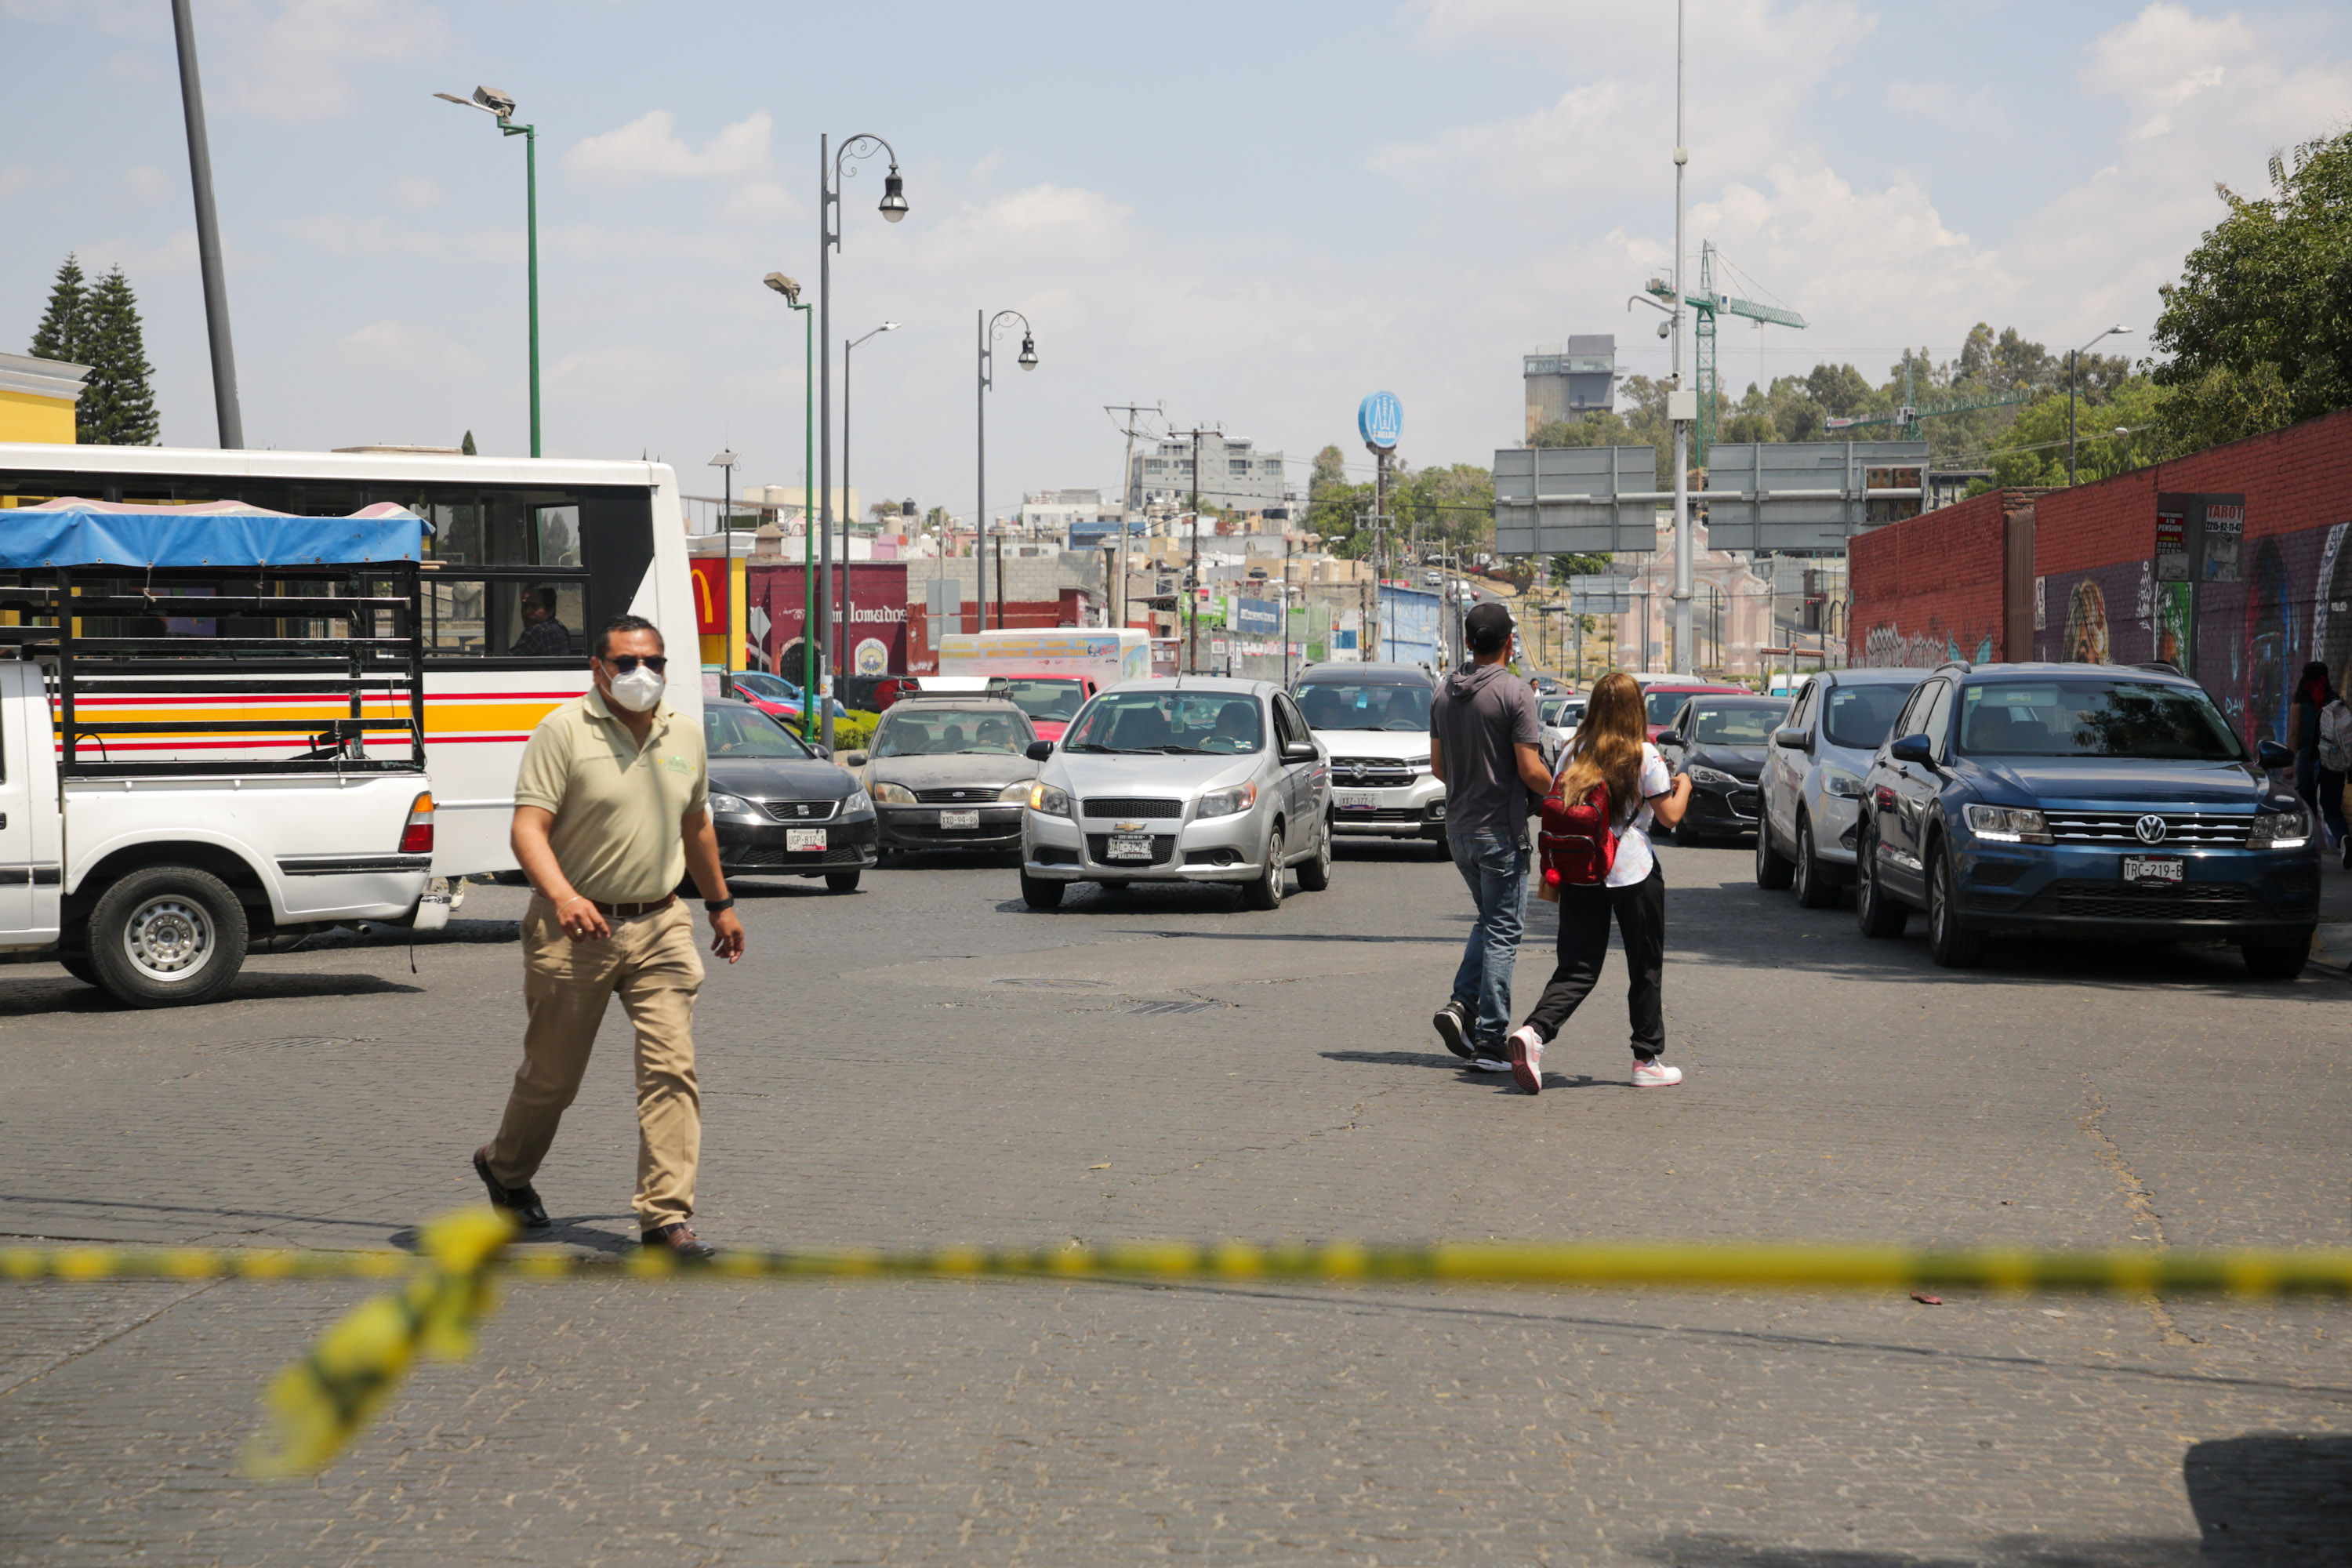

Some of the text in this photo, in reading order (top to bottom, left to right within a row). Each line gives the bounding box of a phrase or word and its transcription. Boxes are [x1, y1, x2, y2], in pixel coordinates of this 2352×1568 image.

[2208, 505, 2242, 519] TAROT
[2158, 524, 2183, 532] PENSION
[2206, 522, 2241, 532] 2215-92-11-47
[789, 835, 825, 845] UGP-812-A
[1109, 841, 1152, 852] UAC-329-A
[2125, 863, 2183, 877] TRC-219-B
